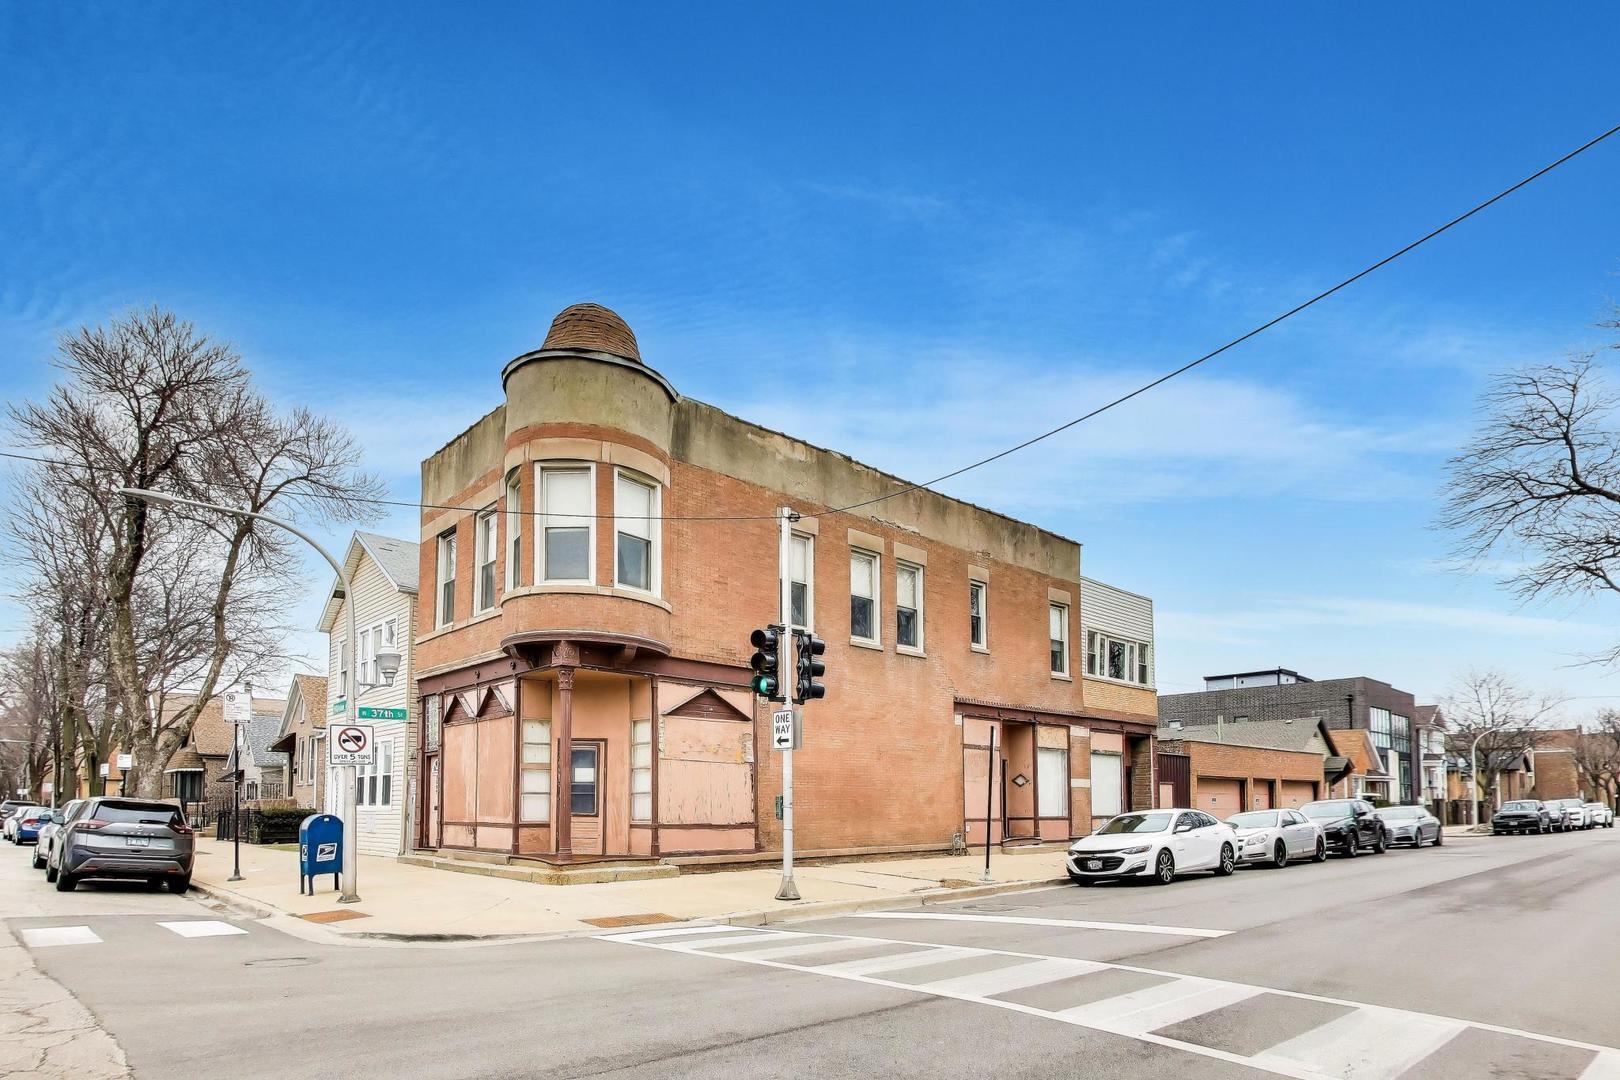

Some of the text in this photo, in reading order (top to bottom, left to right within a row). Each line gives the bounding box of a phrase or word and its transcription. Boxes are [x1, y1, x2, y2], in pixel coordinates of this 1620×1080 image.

[371, 709, 394, 718] 37th
[775, 713, 790, 723] ONE
[775, 724, 790, 734] WAY
